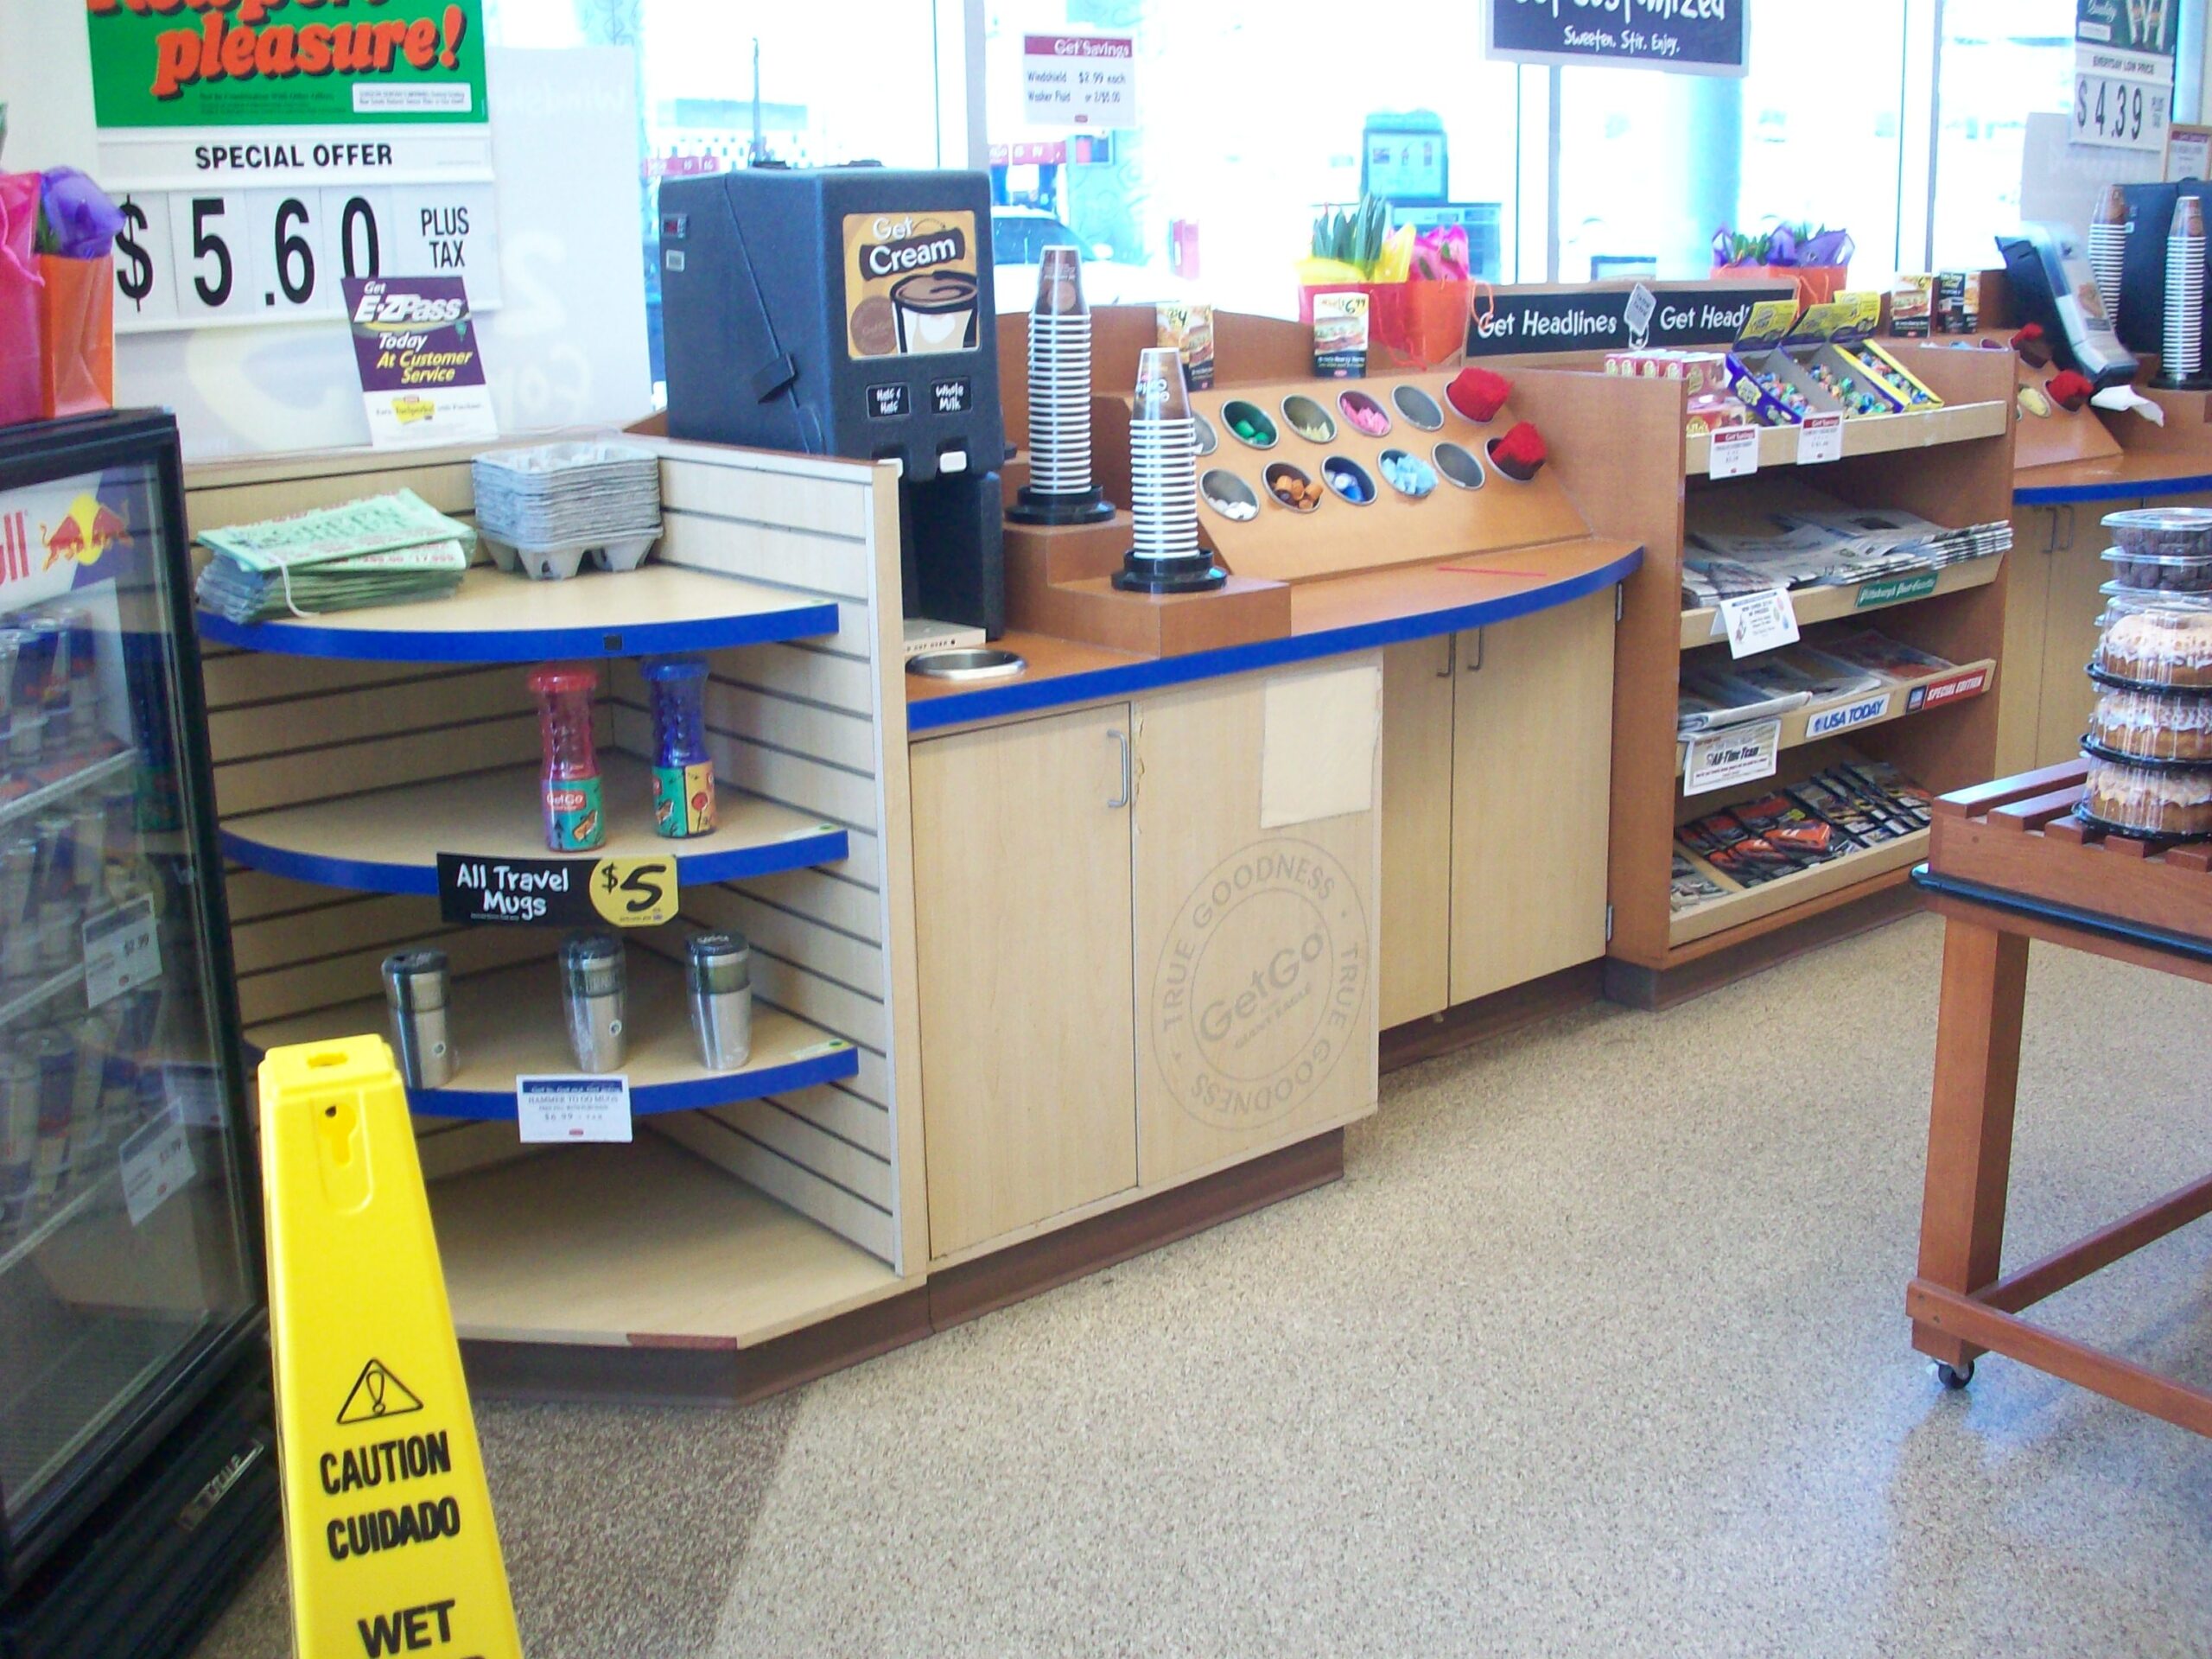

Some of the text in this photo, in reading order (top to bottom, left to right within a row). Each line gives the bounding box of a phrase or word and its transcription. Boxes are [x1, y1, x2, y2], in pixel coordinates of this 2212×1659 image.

[149, 3, 467, 100] pleasure!
[1055, 38, 1130, 58] Get Savings
[1563, 25, 1617, 52] Sweeten.
[1620, 29, 1647, 54] Stir.
[195, 143, 393, 170] SPECIAL OFFER
[421, 206, 470, 238] PLUS
[873, 216, 913, 240] Get
[429, 240, 467, 269] TAX
[869, 238, 956, 276] Cream
[363, 281, 387, 296] Get
[1478, 308, 1618, 338] Get Headlines
[1660, 305, 1694, 332] Get
[378, 332, 429, 352] Today
[377, 349, 474, 369] At Customer
[400, 365, 456, 385] Service
[936, 383, 965, 398] Whole
[939, 395, 961, 412] Milk
[1927, 681, 1955, 702] SPECIAL
[1823, 711, 1847, 731] USA
[1847, 698, 1885, 726] TODAY
[456, 862, 667, 912] All Travel $5
[483, 889, 547, 921] Mugs
[1162, 853, 1335, 1032] TRUE GOODNESS
[1198, 931, 1325, 1042] GetGo
[1191, 942, 1358, 1115] TRUE GOODNESS
[319, 1429, 451, 1496] CAUTION
[327, 1495, 461, 1561] CUIDADO
[357, 1598, 455, 1659] WET
